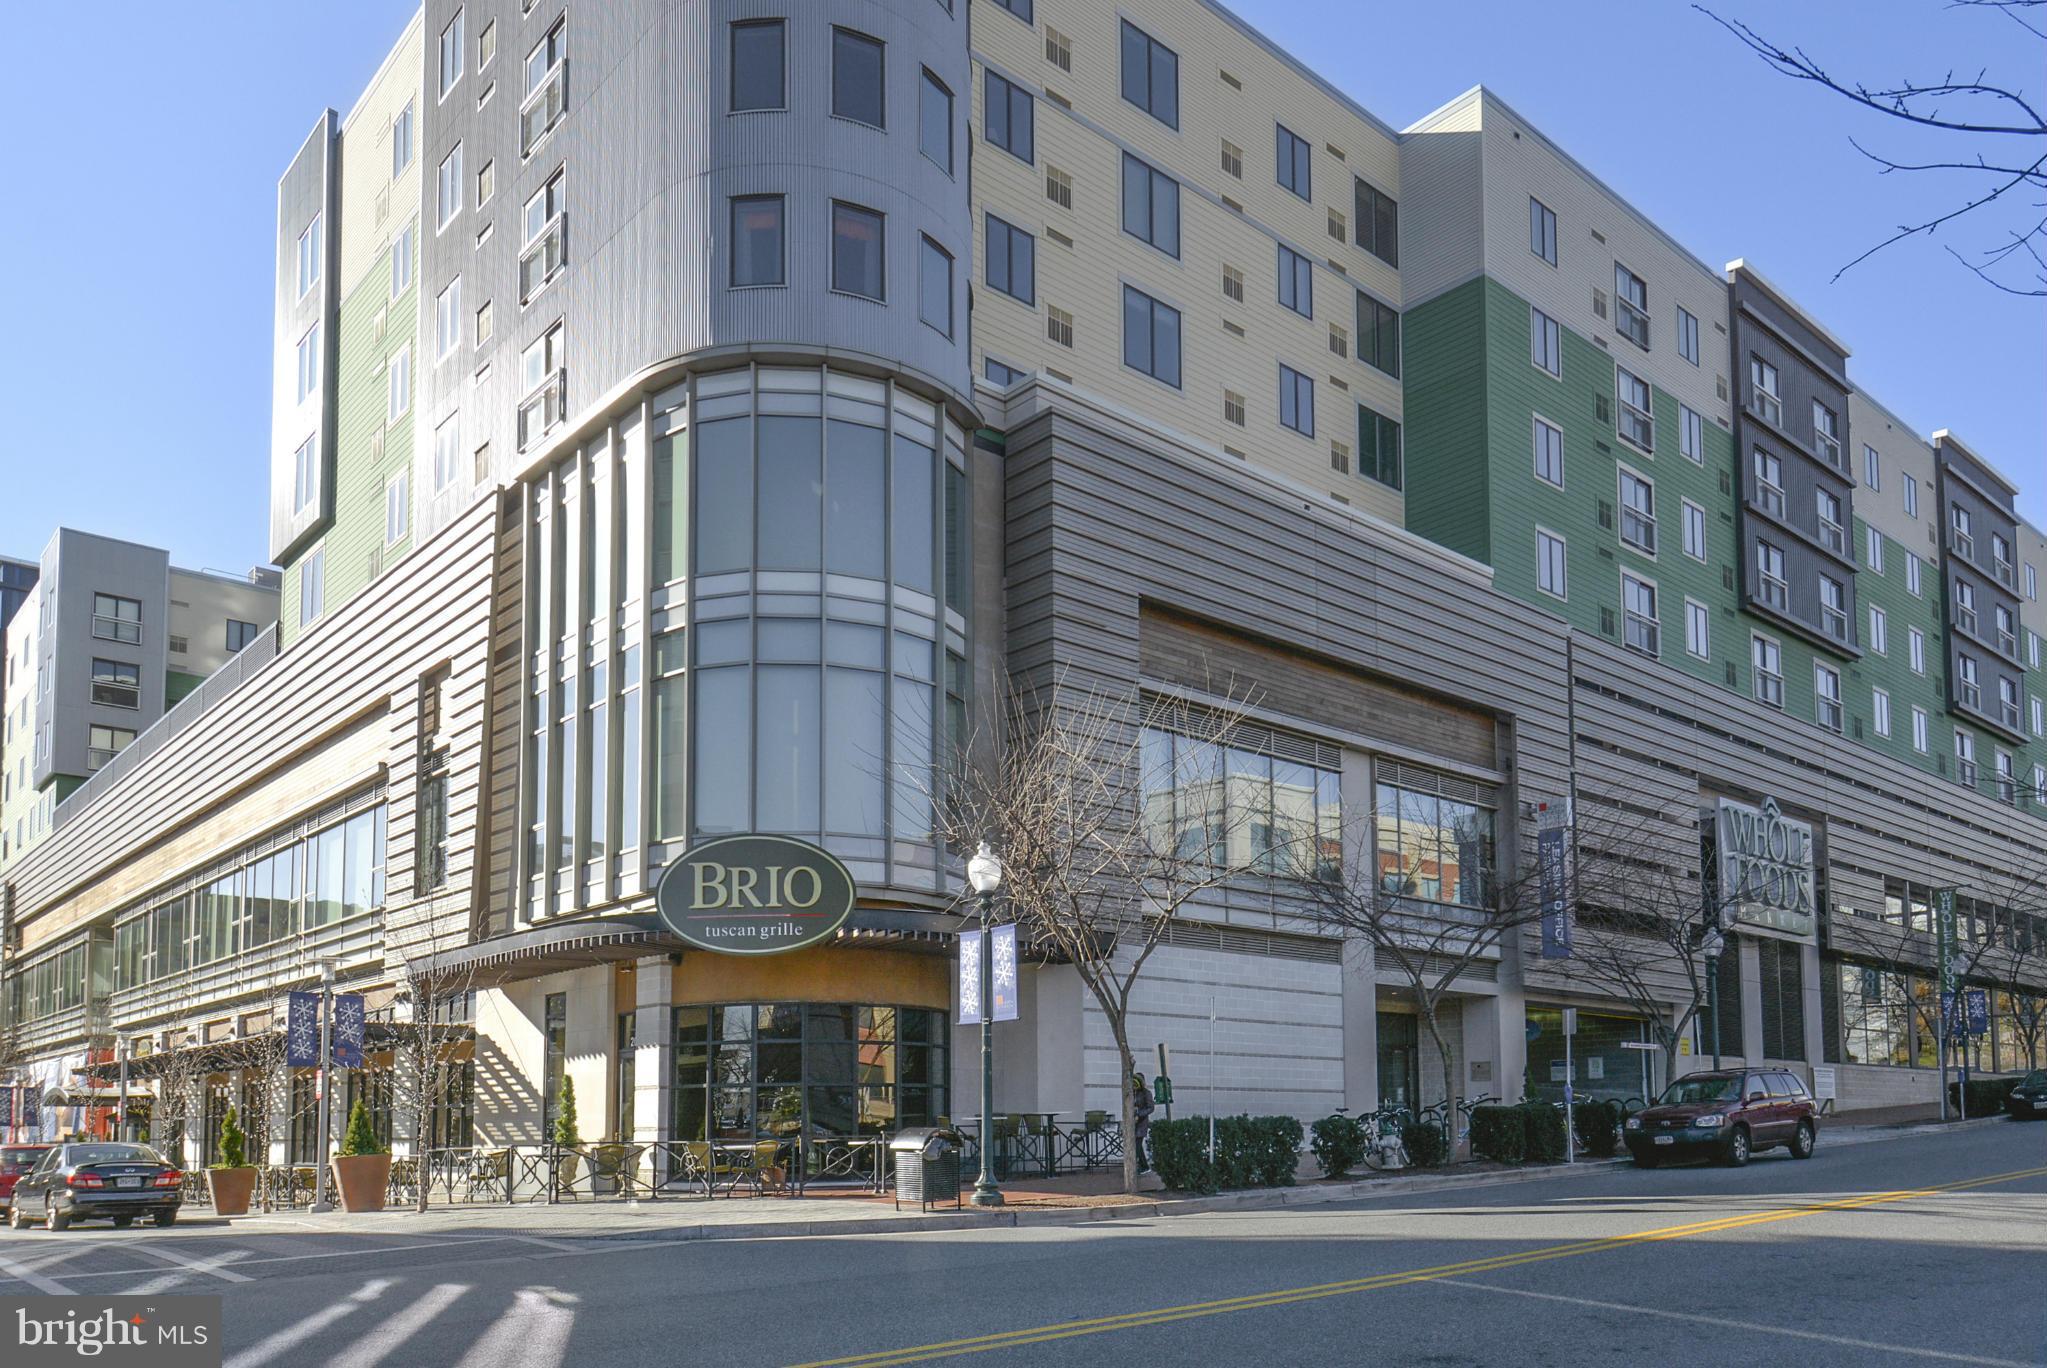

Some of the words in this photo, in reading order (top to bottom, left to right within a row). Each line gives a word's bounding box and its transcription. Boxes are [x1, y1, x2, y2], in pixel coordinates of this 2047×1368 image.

[1721, 806, 1813, 868] WHOLE
[687, 861, 822, 909] BRIO
[1726, 852, 1811, 915] FOODS
[705, 925, 756, 937] tuscan
[760, 922, 803, 939] grille
[1940, 891, 1953, 944] WHOLE
